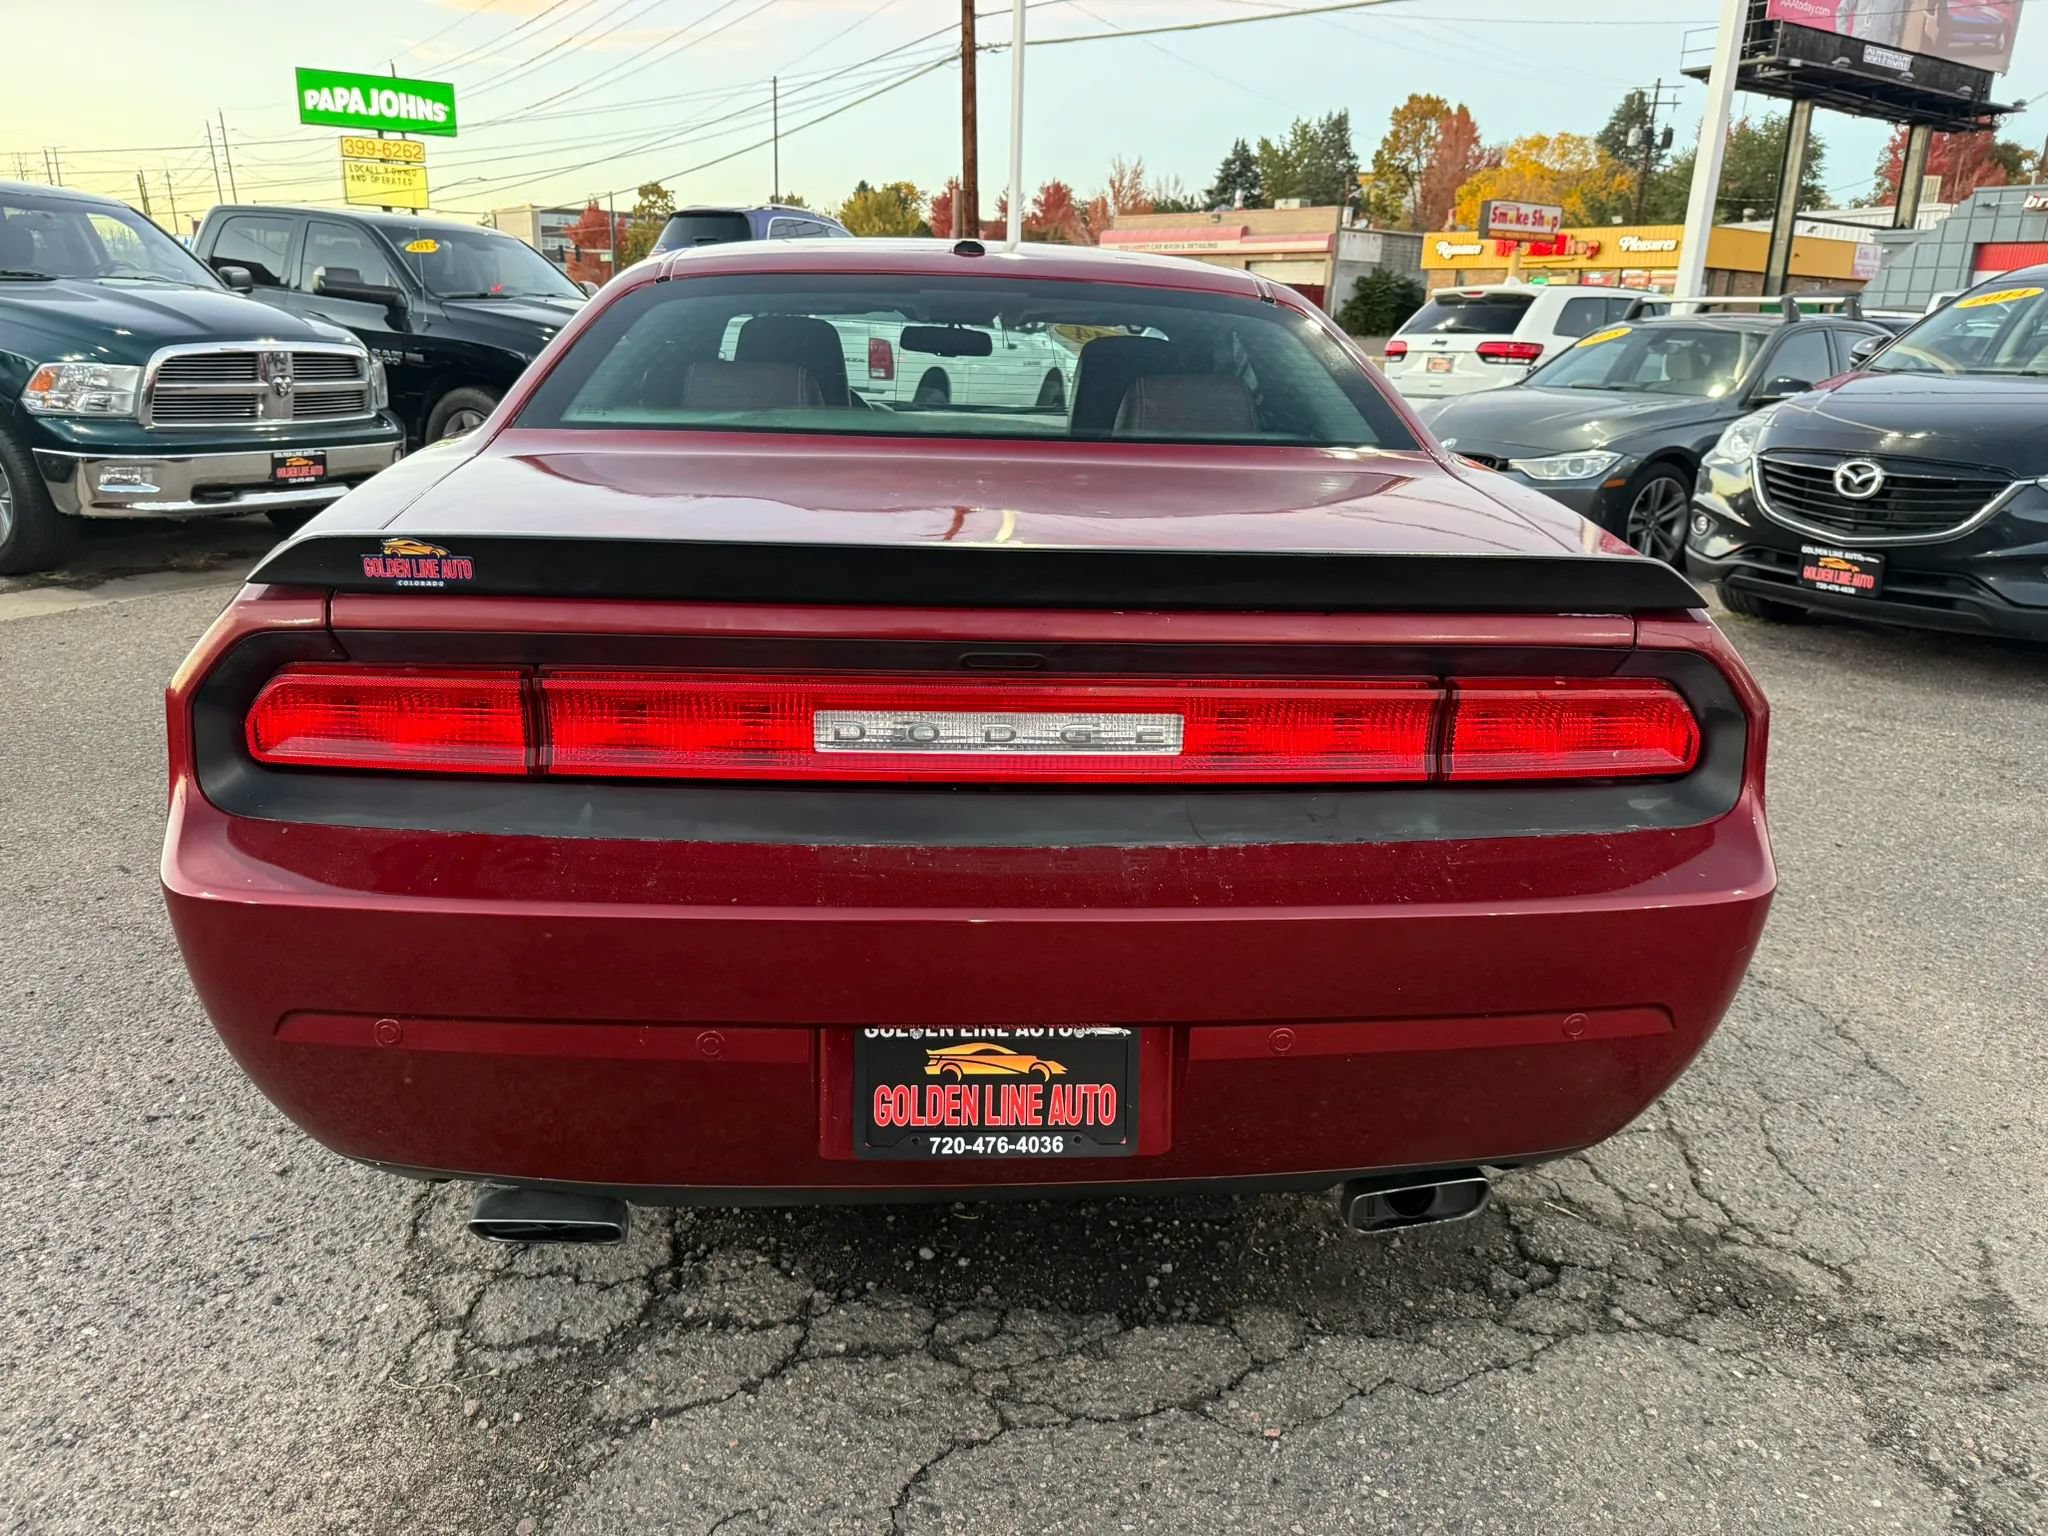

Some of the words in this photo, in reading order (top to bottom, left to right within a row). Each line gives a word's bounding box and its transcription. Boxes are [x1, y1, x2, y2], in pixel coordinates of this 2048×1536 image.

[344, 138, 422, 160] 399-6262
[363, 557, 411, 578] GOLDEN
[412, 558, 439, 579] LINE
[441, 559, 473, 580] AUTO
[1803, 565, 1834, 583] GOLDEN
[1834, 569, 1852, 586] LINE
[1852, 573, 1874, 589] AUTO
[832, 720, 1166, 744] DODGE
[864, 1028, 954, 1039] GOLEN
[873, 1084, 979, 1127] GOLDEN
[984, 1084, 1043, 1126] LINE
[1048, 1083, 1117, 1126] AUTO
[929, 1136, 1064, 1155] 720-476-4036
